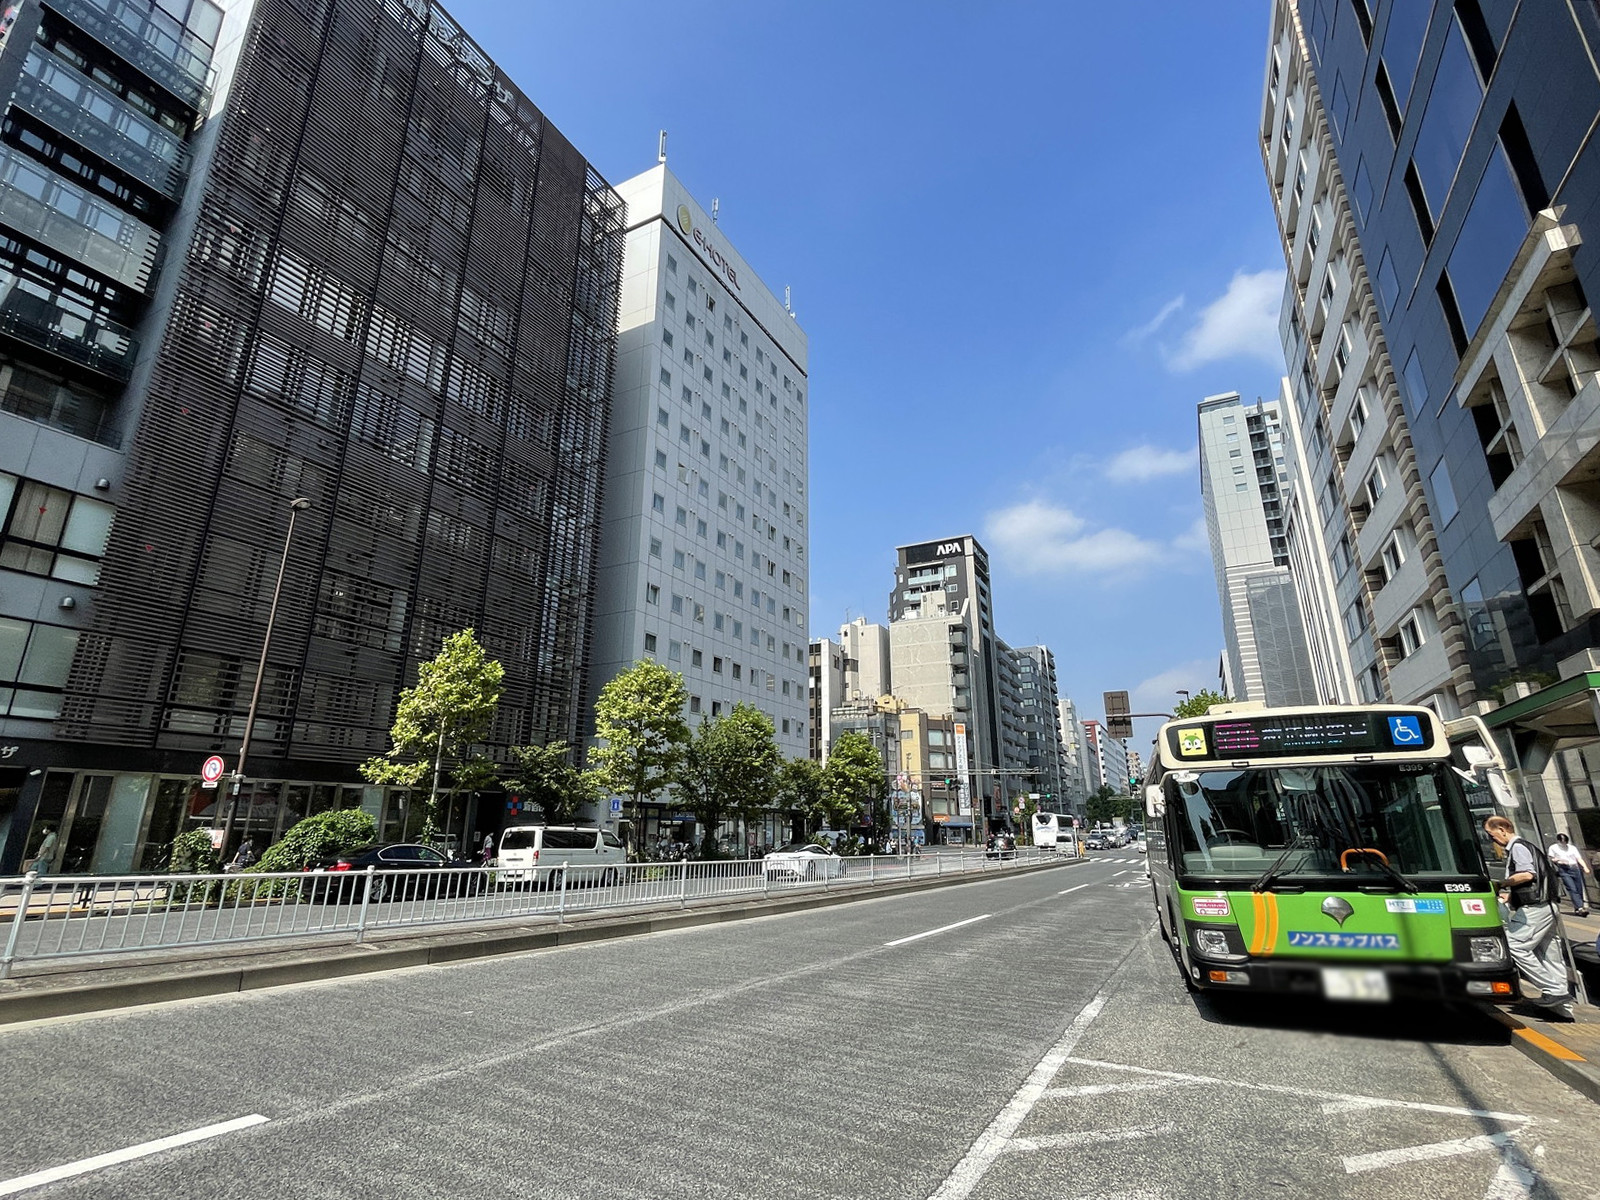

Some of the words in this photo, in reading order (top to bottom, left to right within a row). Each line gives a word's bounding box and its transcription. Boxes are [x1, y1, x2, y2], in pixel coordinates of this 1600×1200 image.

[936, 542, 962, 556] APA
[1398, 763, 1424, 772] E395
[1444, 883, 1472, 893] E395
[1289, 932, 1399, 949] ノンステップバス
